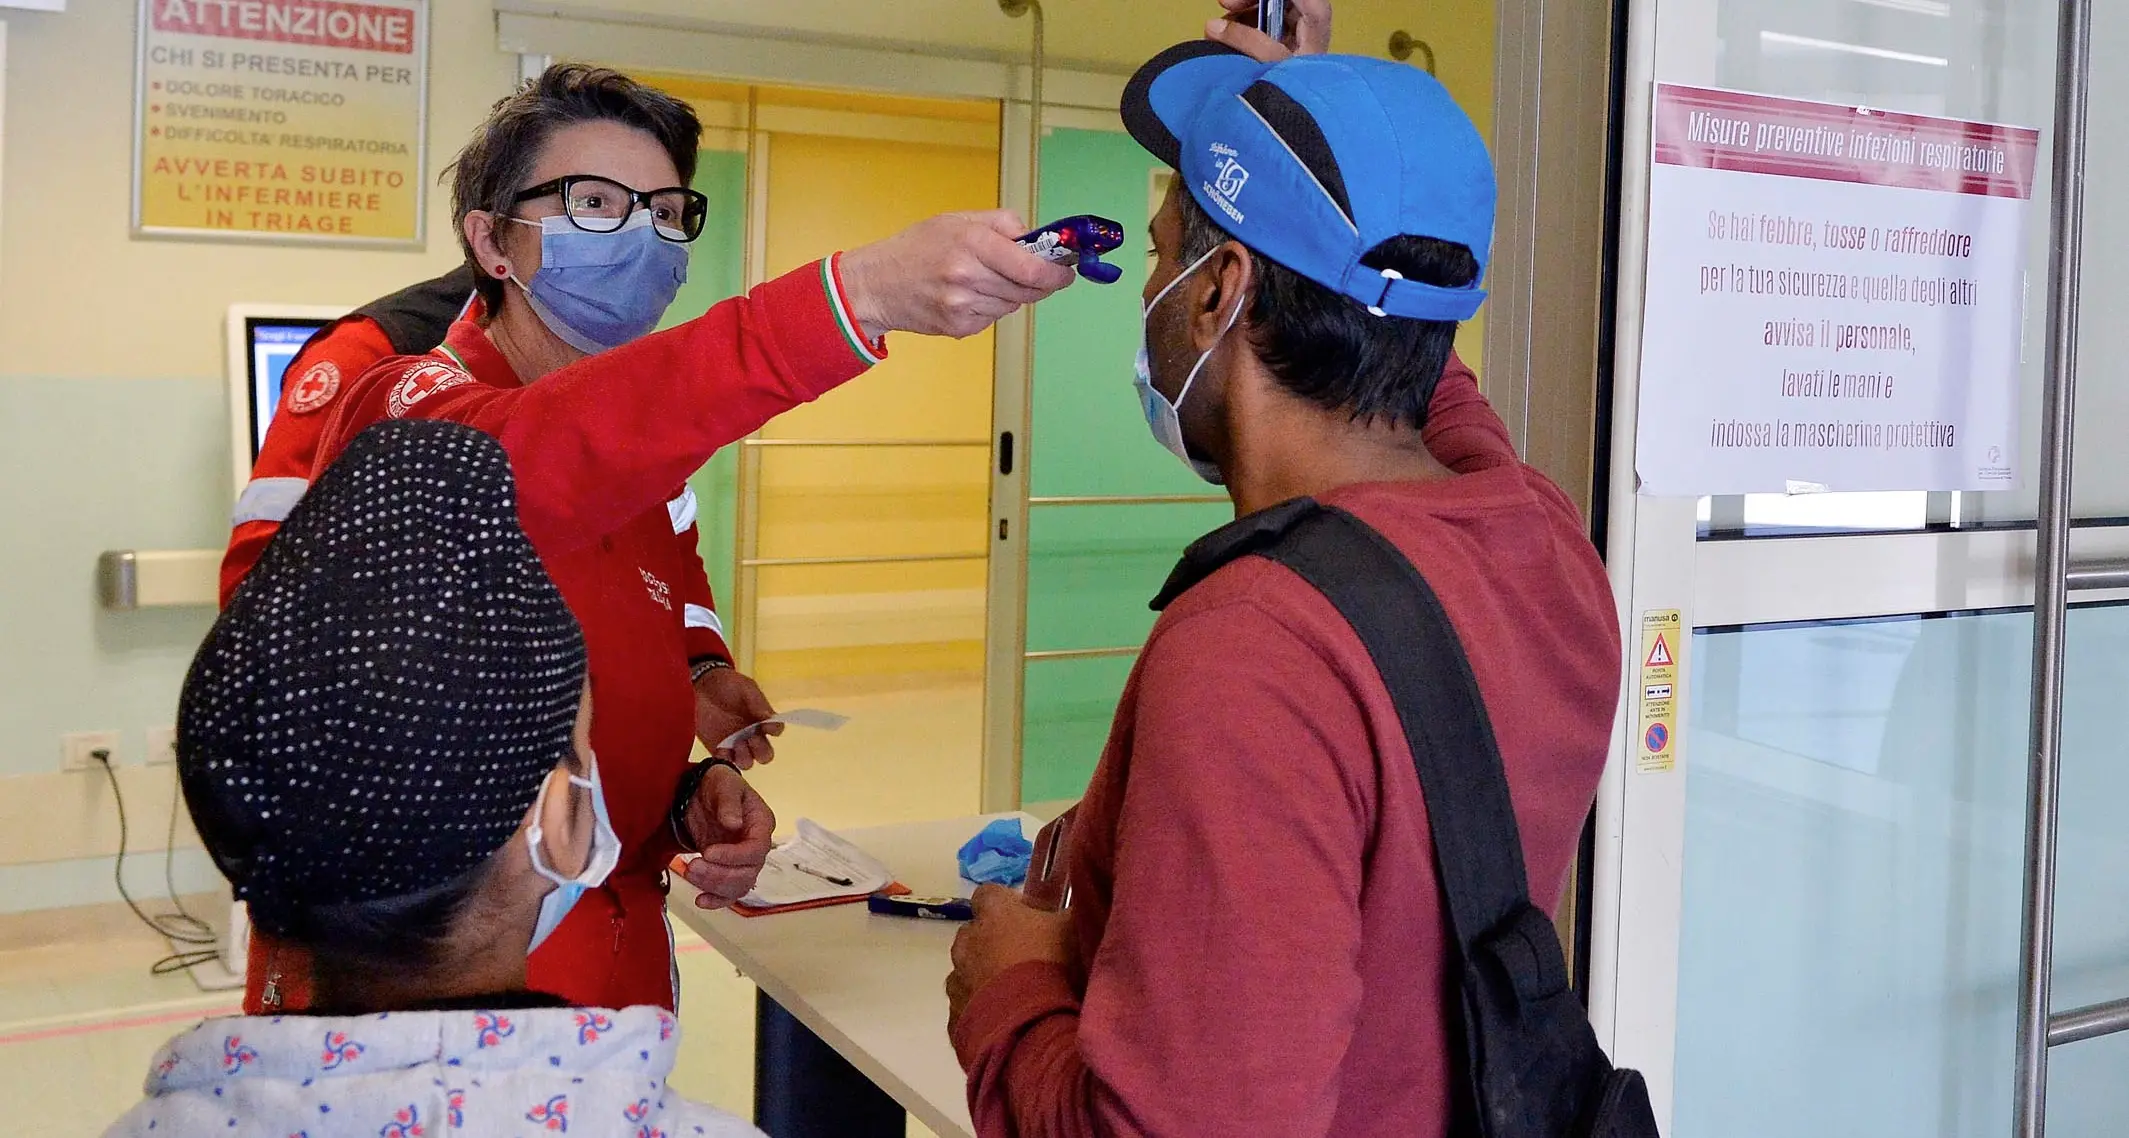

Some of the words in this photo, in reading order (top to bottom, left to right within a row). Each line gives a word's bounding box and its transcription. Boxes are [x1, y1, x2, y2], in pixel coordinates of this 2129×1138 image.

[160, 0, 408, 45] ATTENZIONE
[151, 45, 194, 65] CHI
[202, 50, 225, 68] SI
[232, 53, 359, 82] PRESENTA
[366, 65, 412, 85] PER
[165, 80, 245, 99] DOLORE
[252, 86, 345, 107] TORACICO
[165, 103, 287, 124] SVENIMENTO
[164, 126, 272, 146] DIFFICOLTA'
[280, 134, 409, 156] RESPIRATORIA
[1687, 111, 1751, 147] Misure
[1755, 122, 1844, 157] preventive
[1849, 129, 1916, 165] infezioni
[1920, 144, 2005, 174] respiratorie
[154, 156, 288, 182] AVVERTA
[301, 165, 405, 189] SUBITO
[178, 184, 381, 212] L'INFERMIERE
[206, 211, 233, 228] IN
[251, 212, 353, 234] TRIAGE
[1708, 210, 1726, 241] Se
[1730, 212, 1755, 242] hai
[1759, 214, 1818, 252] febbre,
[1824, 219, 1866, 251] tosse
[1870, 231, 1879, 251] o
[1884, 226, 1972, 259] raffreddore
[1700, 265, 1726, 295] per
[1730, 264, 1744, 293] la
[1748, 268, 1774, 295] tua
[1778, 267, 1847, 299] sicurezza
[1850, 279, 1859, 299] e
[1862, 274, 1907, 304] quella
[1911, 276, 1946, 307] degli
[1949, 277, 1978, 306] altri
[1764, 318, 1814, 347] avvisa
[1820, 319, 1830, 348] il
[1835, 323, 1916, 355] personale,
[1781, 368, 1825, 398] lavati
[1827, 369, 1840, 398] le
[1843, 372, 1883, 399] mani
[1884, 379, 1893, 399] e
[1710, 418, 1772, 448] indossa
[1775, 418, 1790, 448] la
[1793, 419, 1882, 449] mascherina
[1886, 421, 1955, 451] protettiva
[1644, 614, 1670, 623] manusa
